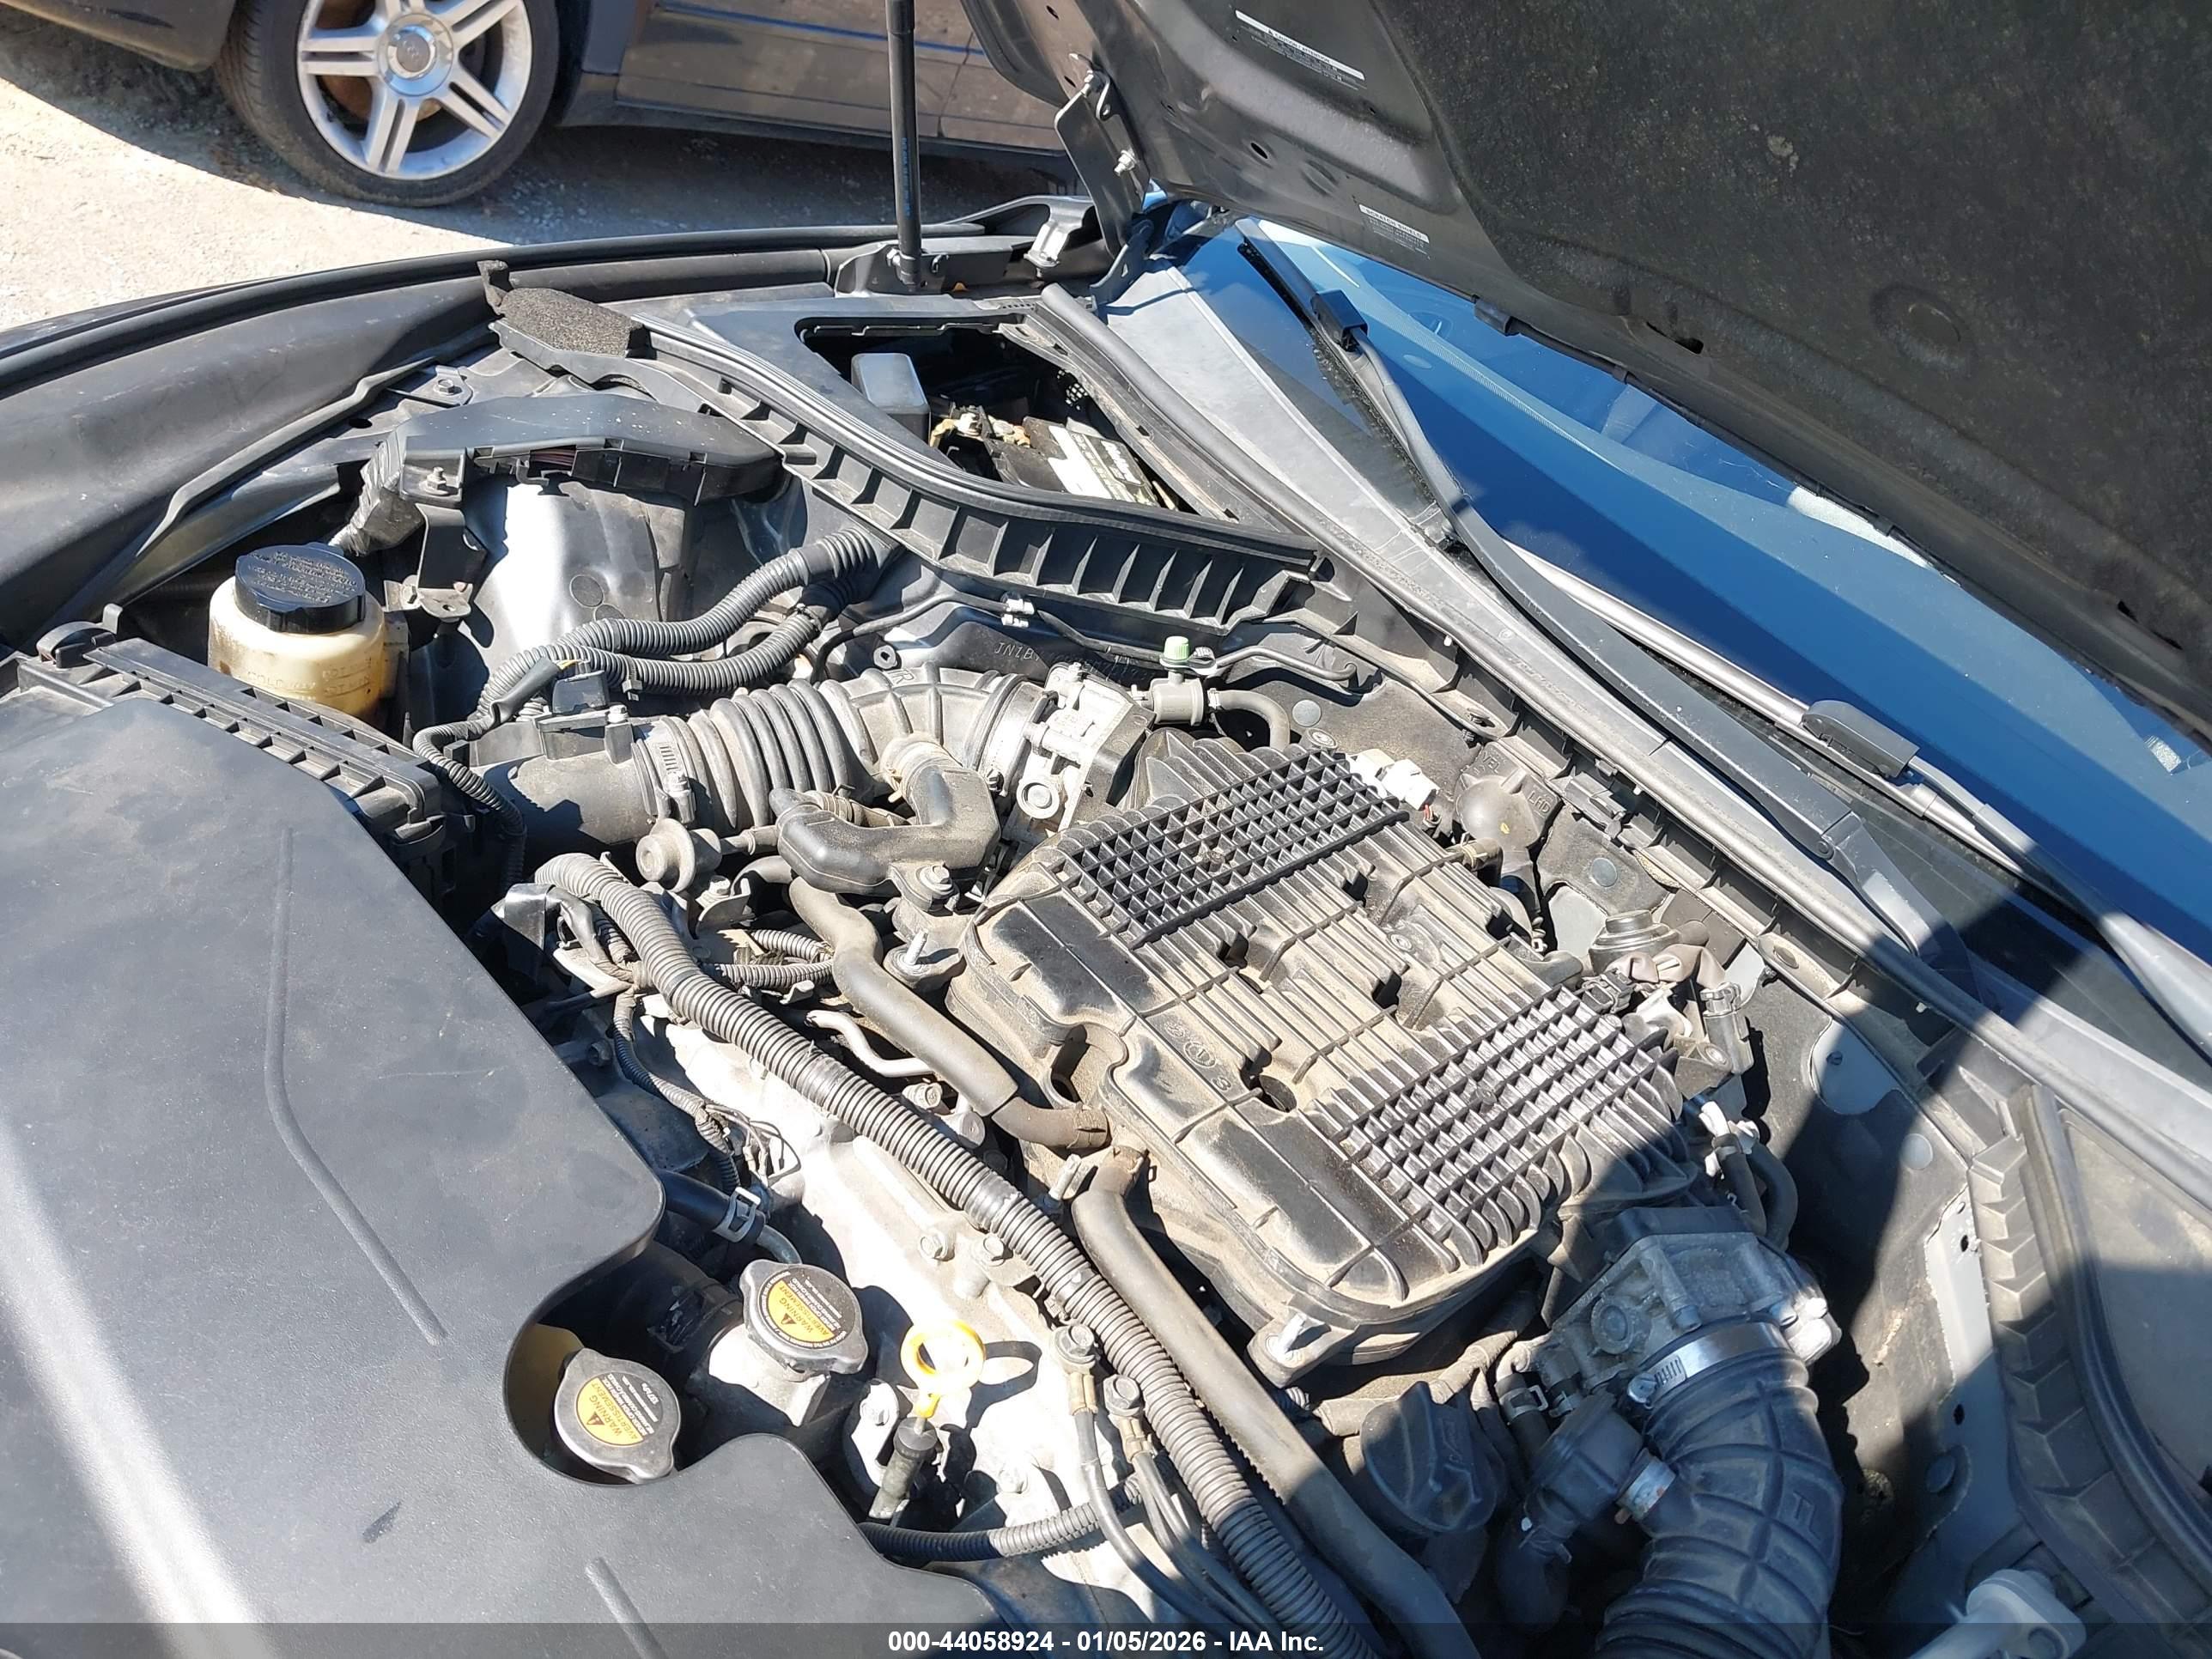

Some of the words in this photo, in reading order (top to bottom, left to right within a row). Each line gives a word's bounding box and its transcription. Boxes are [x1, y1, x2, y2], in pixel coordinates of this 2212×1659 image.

[1528, 790, 1551, 813] LHD
[778, 1283, 829, 1337] AVERTISSEMENT
[779, 1296, 813, 1333] WARNING
[587, 1394, 623, 1437] WARNING
[589, 1380, 639, 1441] AVERTISSEMENT
